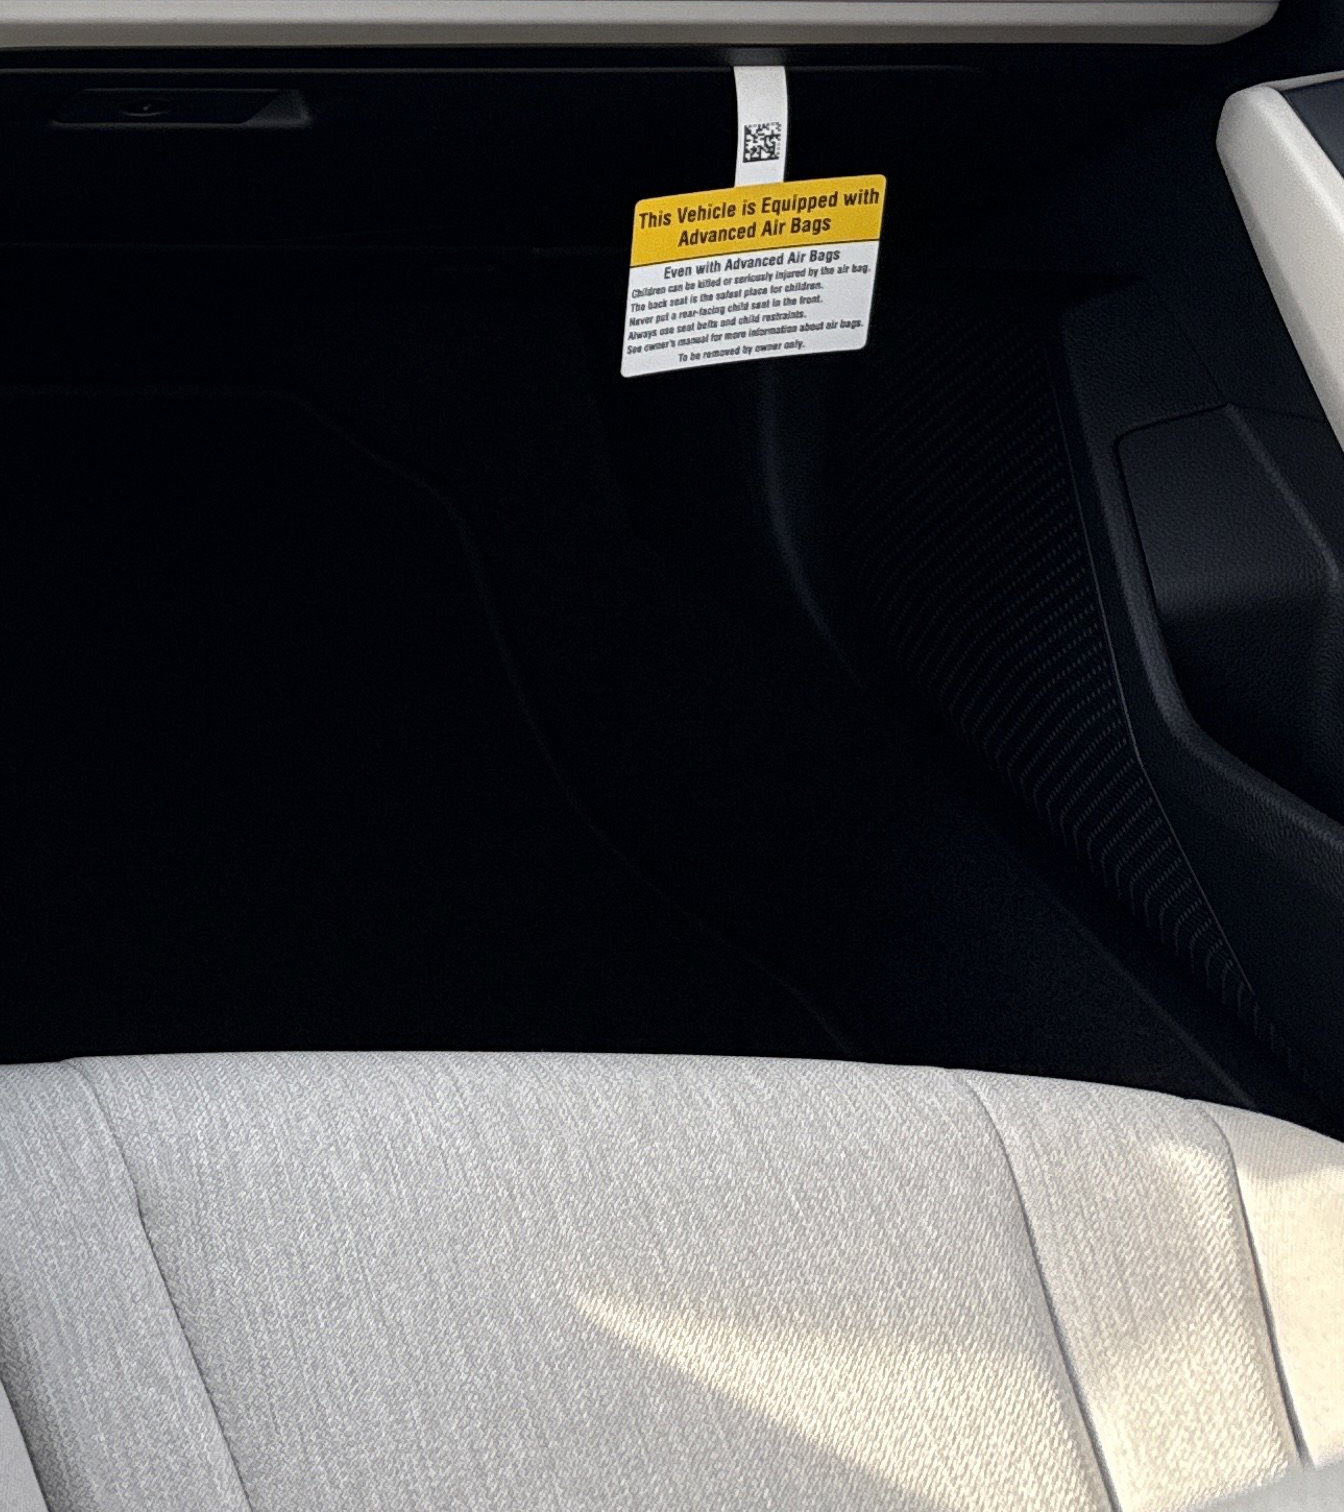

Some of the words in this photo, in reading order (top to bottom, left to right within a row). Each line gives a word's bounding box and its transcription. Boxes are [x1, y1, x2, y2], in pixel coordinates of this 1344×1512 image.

[639, 210, 672, 230] This
[677, 202, 736, 224] Vehicle
[741, 198, 756, 217] is
[761, 190, 838, 214] Equipped
[843, 188, 880, 206] with
[677, 221, 756, 248] Advanced
[760, 219, 787, 236] Air
[790, 215, 832, 236] Bags
[631, 286, 666, 299] Children
[667, 284, 683, 293] can
[684, 281, 696, 291] be
[697, 277, 721, 289] killed
[723, 276, 732, 286] or
[733, 271, 773, 285] seriously
[775, 268, 806, 281] injured
[808, 267, 818, 278] by
[820, 265, 835, 276] the
[837, 264, 850, 274] air
[851, 263, 871, 275] bag.
[663, 266, 692, 280] Even
[695, 260, 721, 275] with
[724, 253, 784, 272] Advanced
[787, 251, 806, 265] Air
[809, 249, 841, 264] Bags
[629, 315, 653, 327] Never
[655, 311, 670, 324] put
[678, 304, 726, 320] rear-facing
[727, 301, 749, 313] child
[751, 299, 770, 309] seat
[772, 297, 781, 308] in
[782, 296, 797, 307] the
[799, 294, 824, 305] front.
[630, 302, 646, 313] The
[647, 299, 667, 310] back
[669, 296, 688, 307] seat
[689, 294, 698, 304] is
[700, 292, 714, 303] the
[715, 288, 742, 301] safest
[743, 286, 768, 299] place
[770, 284, 783, 294] for
[626, 344, 642, 355] See
[643, 339, 676, 353] owner's
[677, 333, 709, 347] manual
[710, 332, 723, 342] for
[724, 329, 747, 341] more
[748, 324, 798, 338] information
[799, 321, 824, 332] about
[825, 319, 839, 330] air
[839, 318, 864, 331] bags.
[627, 329, 658, 341] Always
[659, 326, 675, 336] use
[676, 322, 695, 334] seat
[696, 319, 718, 331] belts
[720, 316, 736, 328] and
[738, 313, 760, 325] child
[761, 310, 807, 323] restraints.
[678, 352, 688, 363] To
[689, 351, 701, 361] be
[702, 344, 741, 358] removed
[742, 344, 753, 356] by
[754, 341, 782, 353] owner
[783, 338, 806, 351] only.
